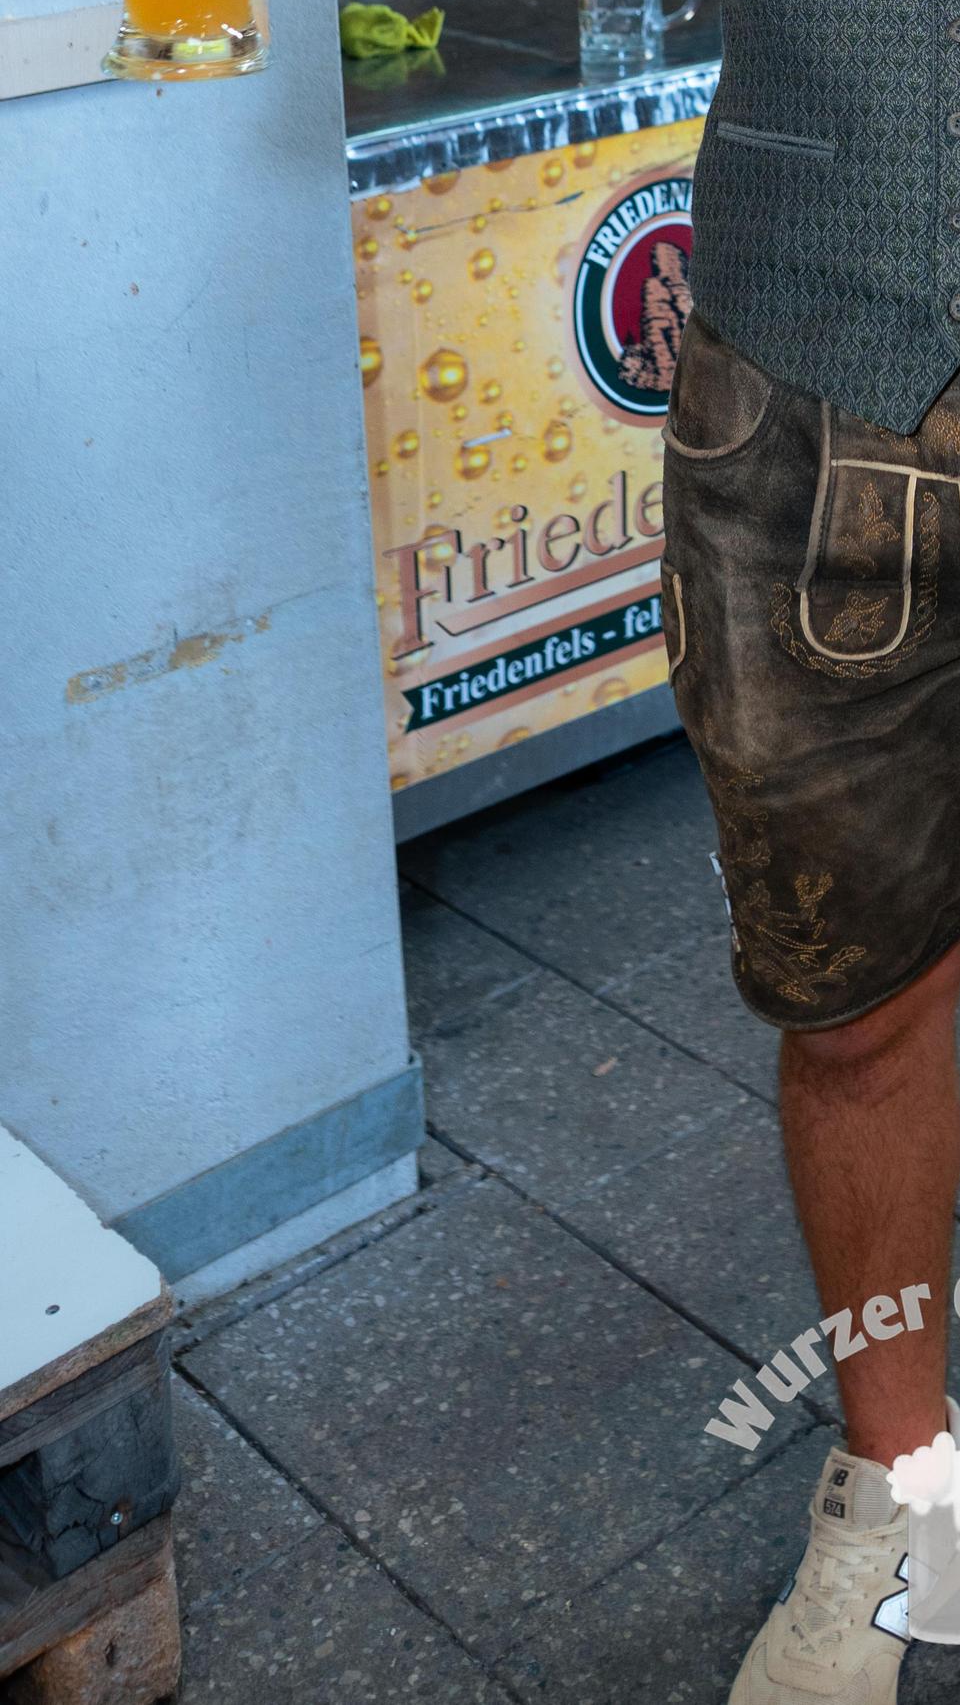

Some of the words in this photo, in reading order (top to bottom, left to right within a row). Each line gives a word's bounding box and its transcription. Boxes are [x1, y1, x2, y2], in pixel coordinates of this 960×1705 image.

[586, 180, 692, 269] FRIEDEN
[421, 628, 596, 720] Friedenfels
[622, 598, 662, 639] fel
